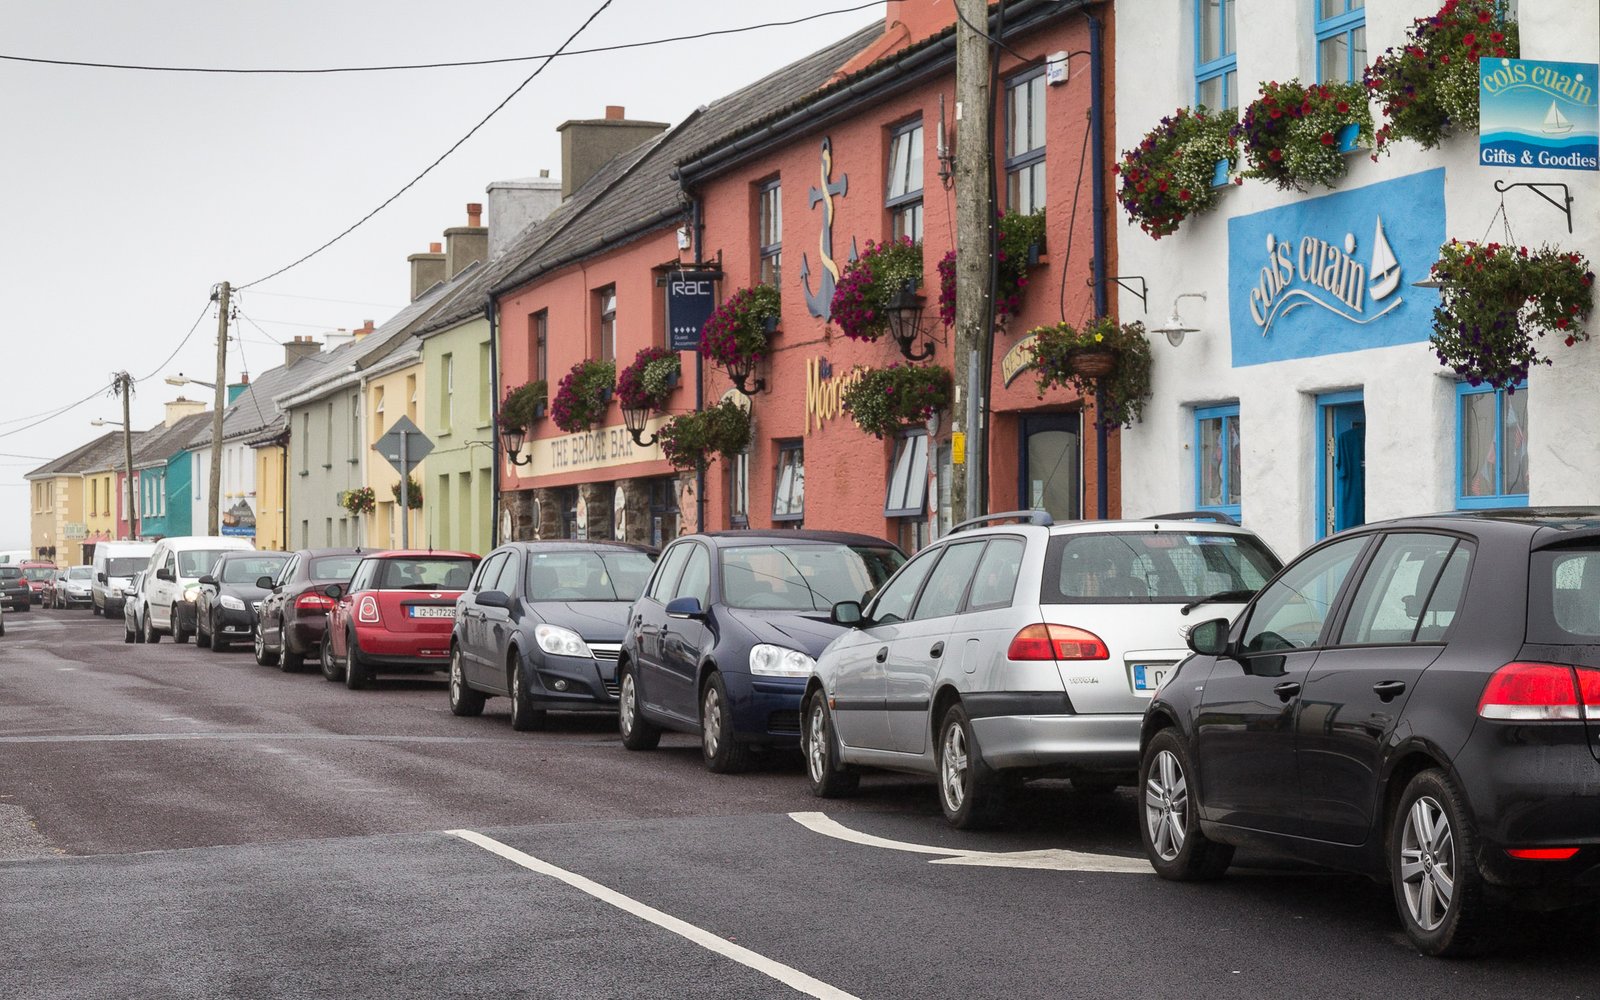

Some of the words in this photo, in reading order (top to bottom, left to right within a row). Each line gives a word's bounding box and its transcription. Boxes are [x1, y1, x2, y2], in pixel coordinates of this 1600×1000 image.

[1483, 58, 1527, 93] cois
[1531, 66, 1592, 104] cuain
[1482, 148, 1516, 164] Gifts
[1520, 149, 1534, 165] &
[1538, 151, 1597, 167] Goodies
[1250, 233, 1295, 327] cois
[1298, 233, 1365, 313] cuain
[551, 440, 568, 468] THE
[572, 431, 606, 465] BRIDGE
[611, 428, 633, 458] BAR
